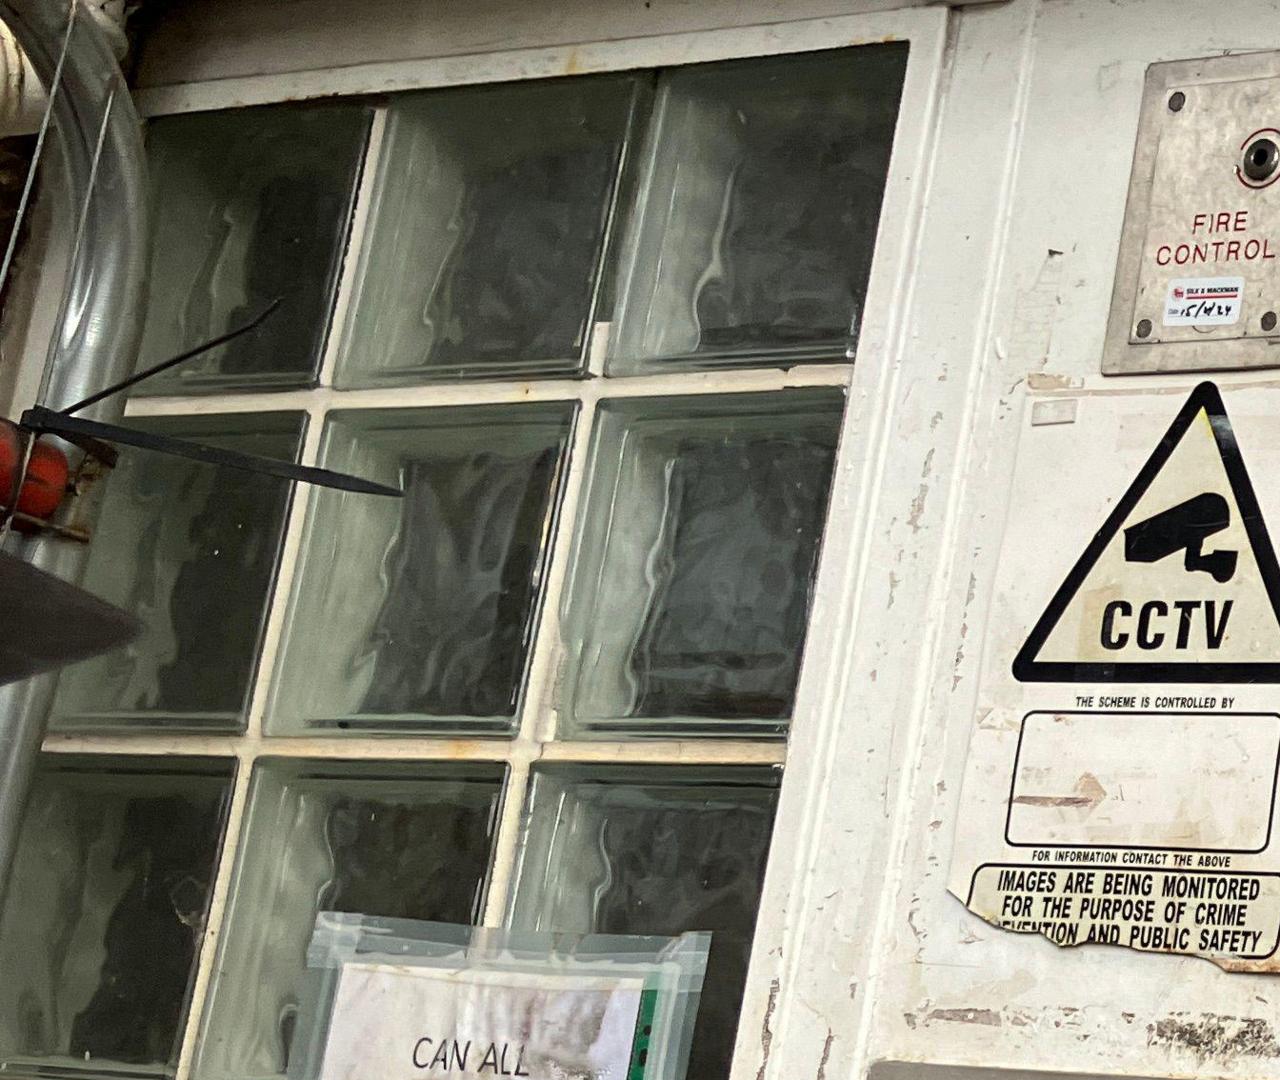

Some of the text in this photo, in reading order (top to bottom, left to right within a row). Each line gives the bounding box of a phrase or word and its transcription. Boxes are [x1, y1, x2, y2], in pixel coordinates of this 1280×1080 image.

[1192, 210, 1248, 234] FIRE
[1156, 238, 1276, 265] CONTROL
[1100, 600, 1234, 650] CCTV
[1076, 696, 1234, 708] THE SCHEME IS CONTROLLED BY
[1032, 850, 1231, 867] FOR INFORMATION CONTACT THE ABOVE
[997, 870, 1260, 901] IMAGES ARE BEING MONITORED
[1001, 895, 1248, 926] FOR THE PURPOSE OF CRIME
[1087, 924, 1120, 945] AND
[1130, 925, 1190, 950] PUBLIC
[1199, 930, 1263, 953] SAFETY
[412, 1037, 529, 1076] CAN ALL
